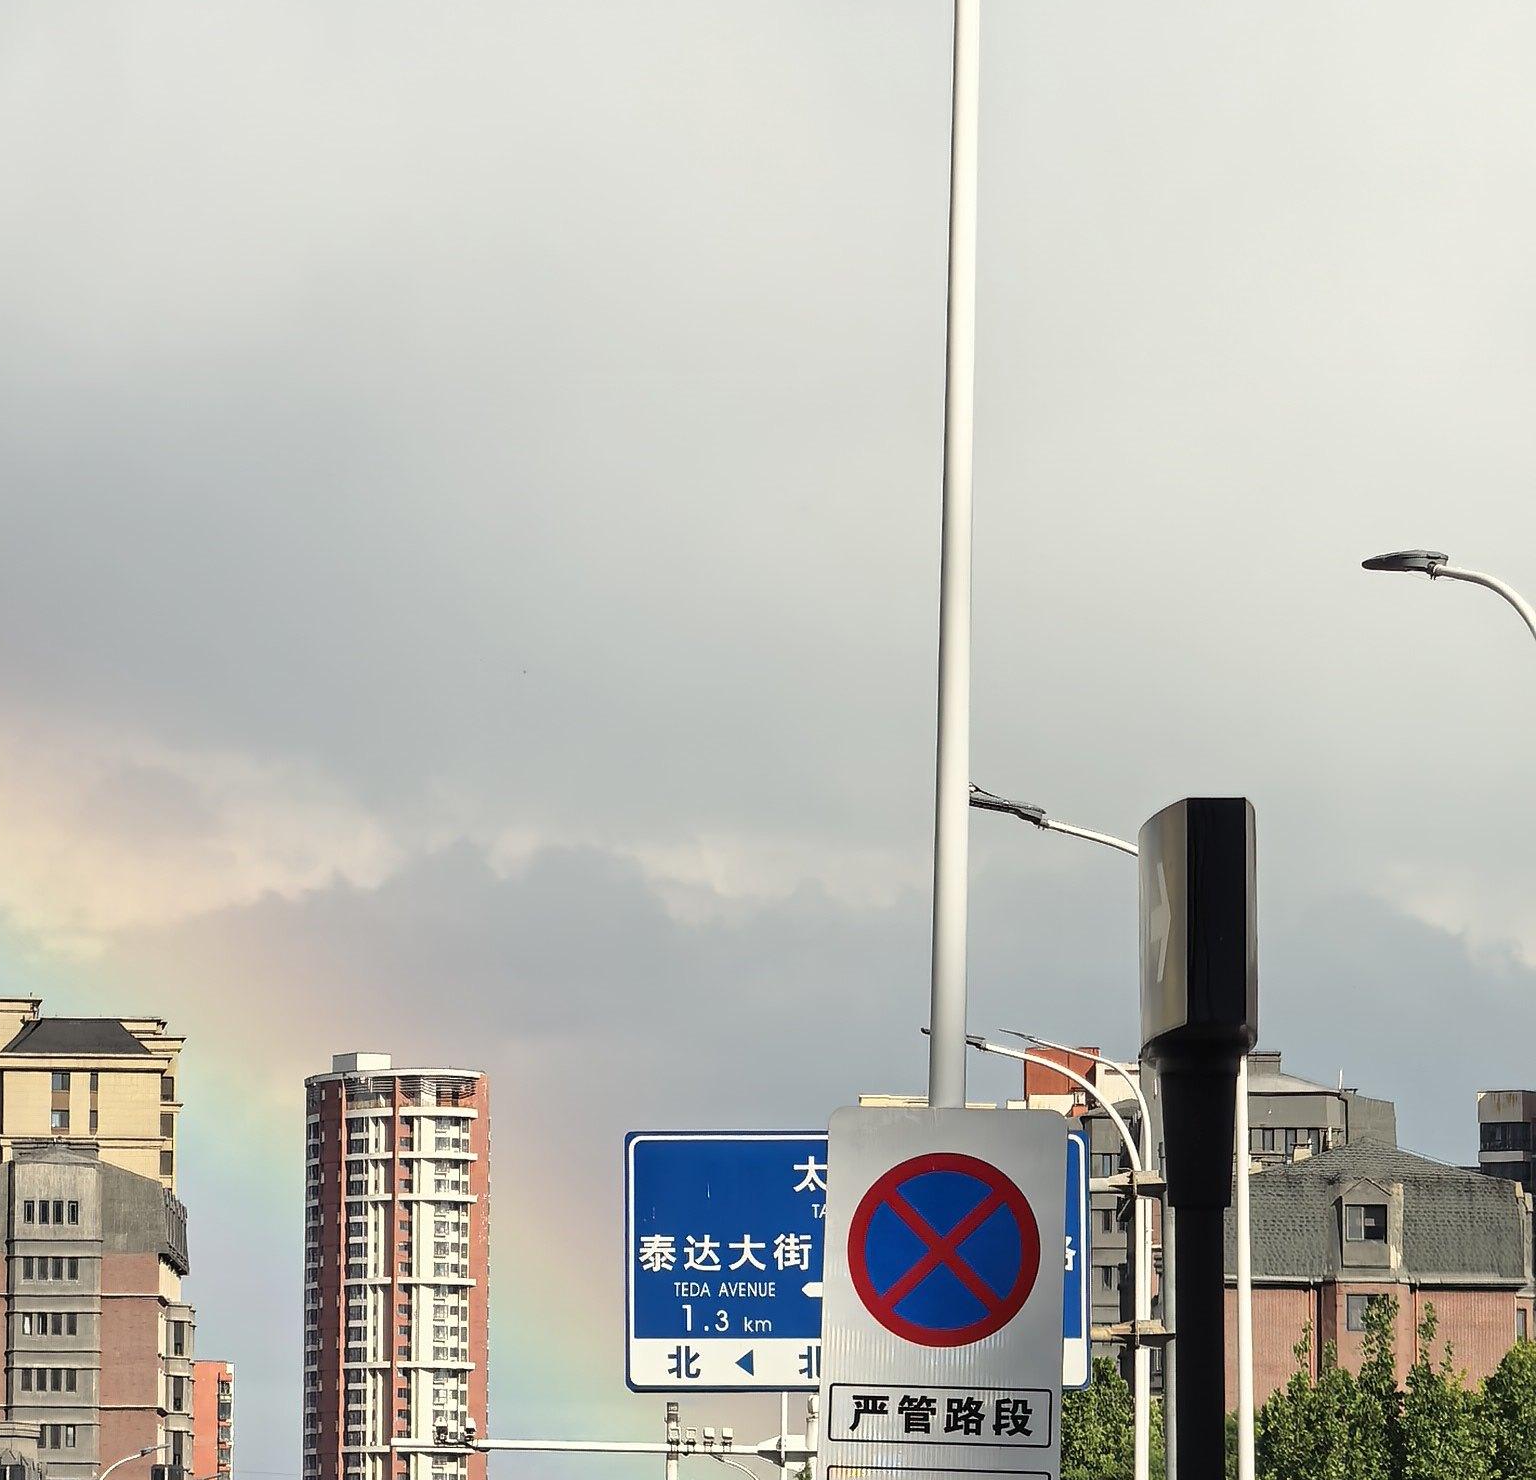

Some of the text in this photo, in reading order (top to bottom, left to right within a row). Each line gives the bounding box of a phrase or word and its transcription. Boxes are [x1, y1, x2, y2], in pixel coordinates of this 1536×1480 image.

[793, 1155, 828, 1192] 太
[638, 1233, 813, 1272] 泰达大街
[674, 1282, 776, 1298] TEDA AVENUE
[681, 1304, 773, 1333] 1.3 km
[667, 1345, 702, 1379] 北
[849, 1394, 1033, 1437] 严管路段
